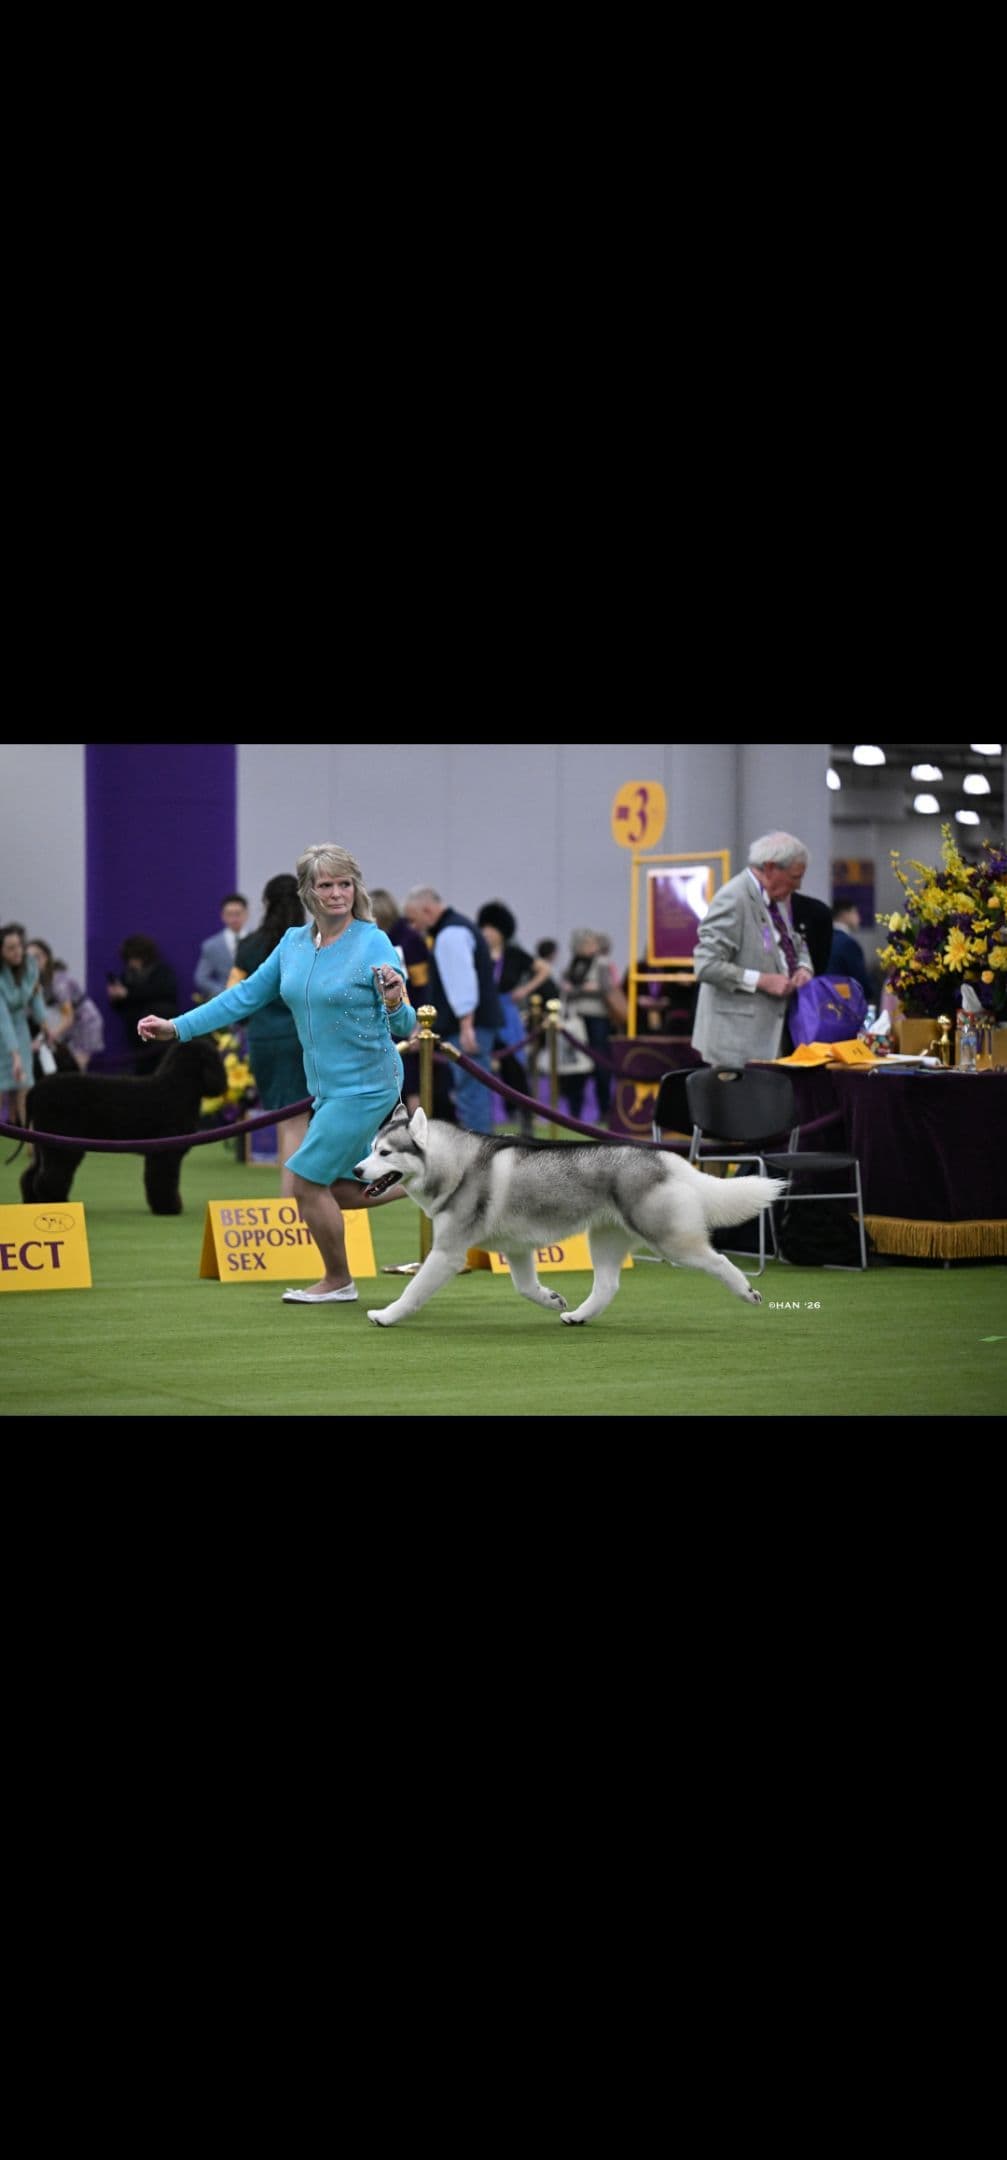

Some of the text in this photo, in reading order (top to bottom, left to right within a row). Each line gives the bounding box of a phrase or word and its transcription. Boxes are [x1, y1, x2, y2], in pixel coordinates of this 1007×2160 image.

[220, 1206, 304, 1226] BEST O
[224, 1228, 312, 1249] OPPOSIT
[0, 1241, 64, 1271] ECT
[227, 1252, 267, 1271] SEX
